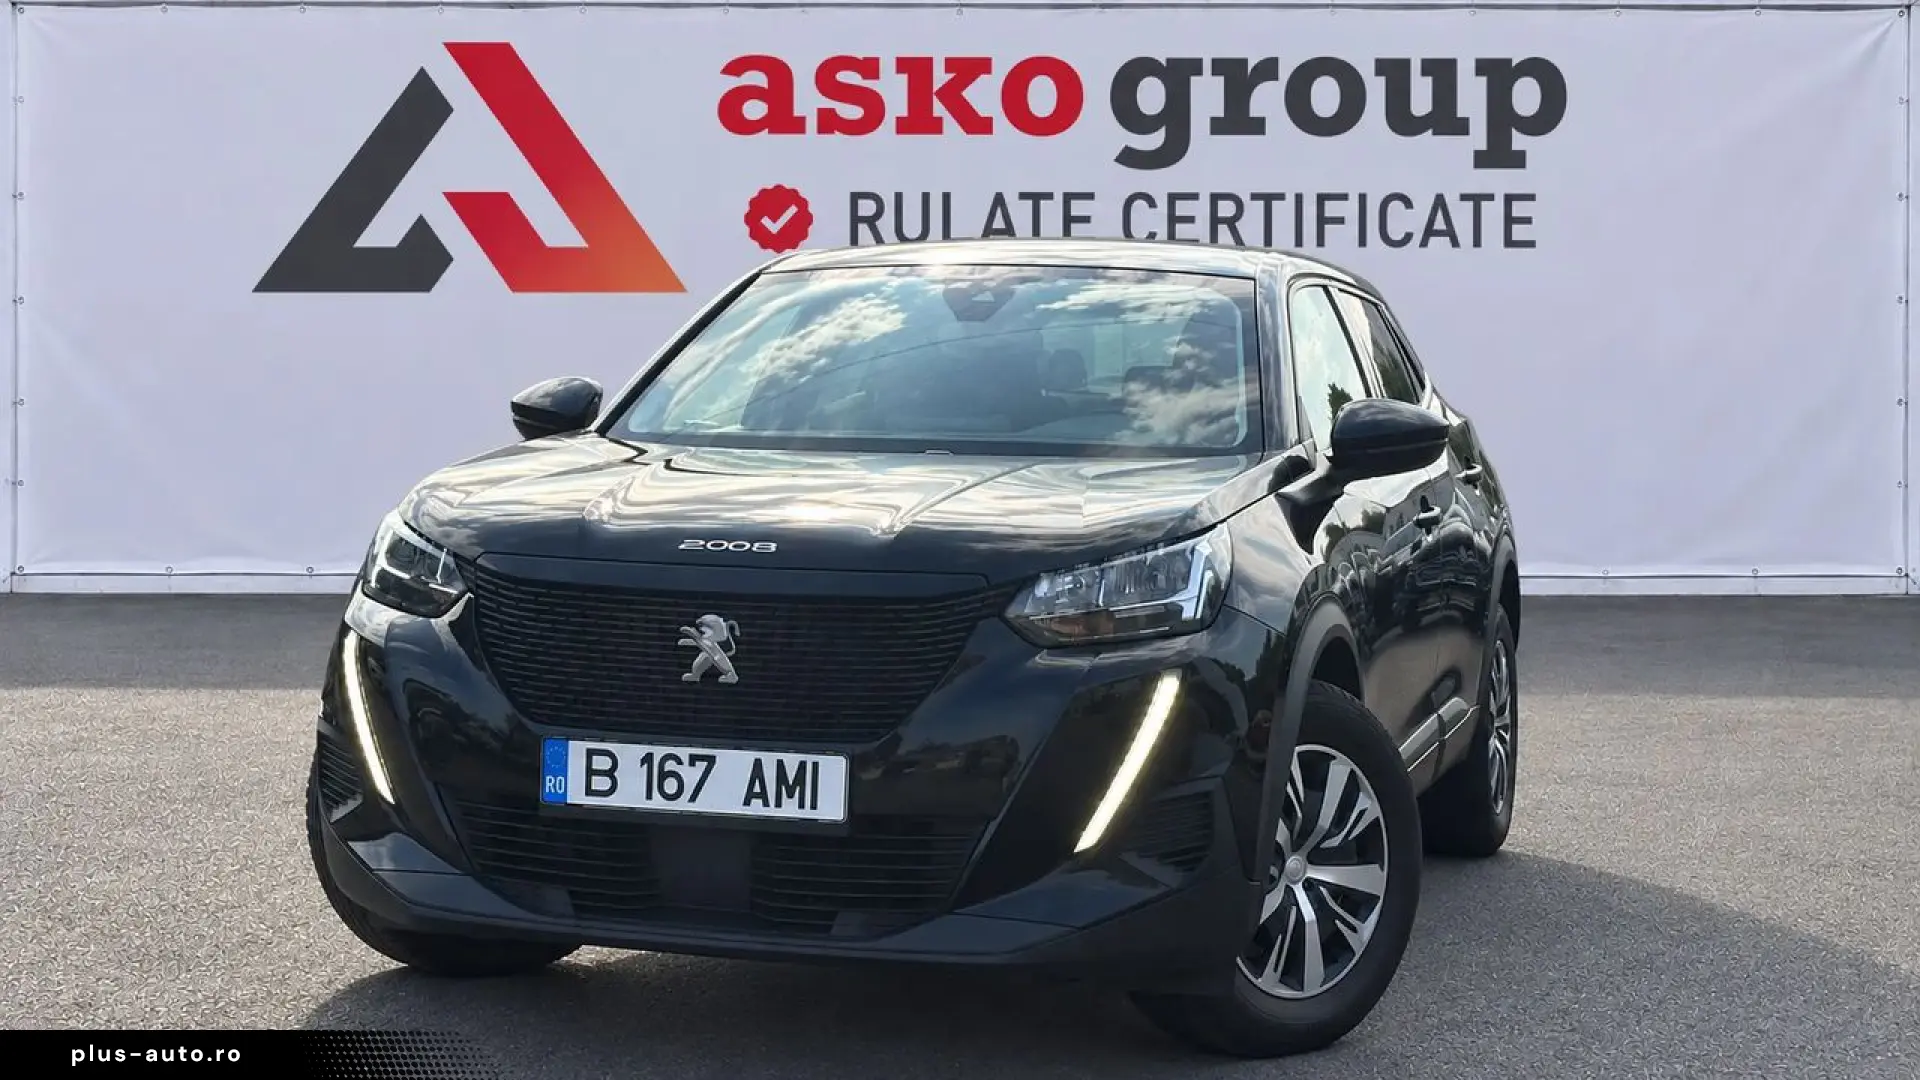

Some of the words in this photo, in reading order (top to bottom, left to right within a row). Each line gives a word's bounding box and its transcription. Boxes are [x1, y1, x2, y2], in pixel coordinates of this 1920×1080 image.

[719, 55, 1084, 136] asko
[1110, 56, 1567, 170] group
[1121, 192, 1537, 249] CERTIFICATE
[678, 539, 778, 553] 2008
[545, 776, 565, 794] RO
[584, 747, 619, 798] B
[639, 752, 717, 803] 167
[742, 758, 820, 811] AMI
